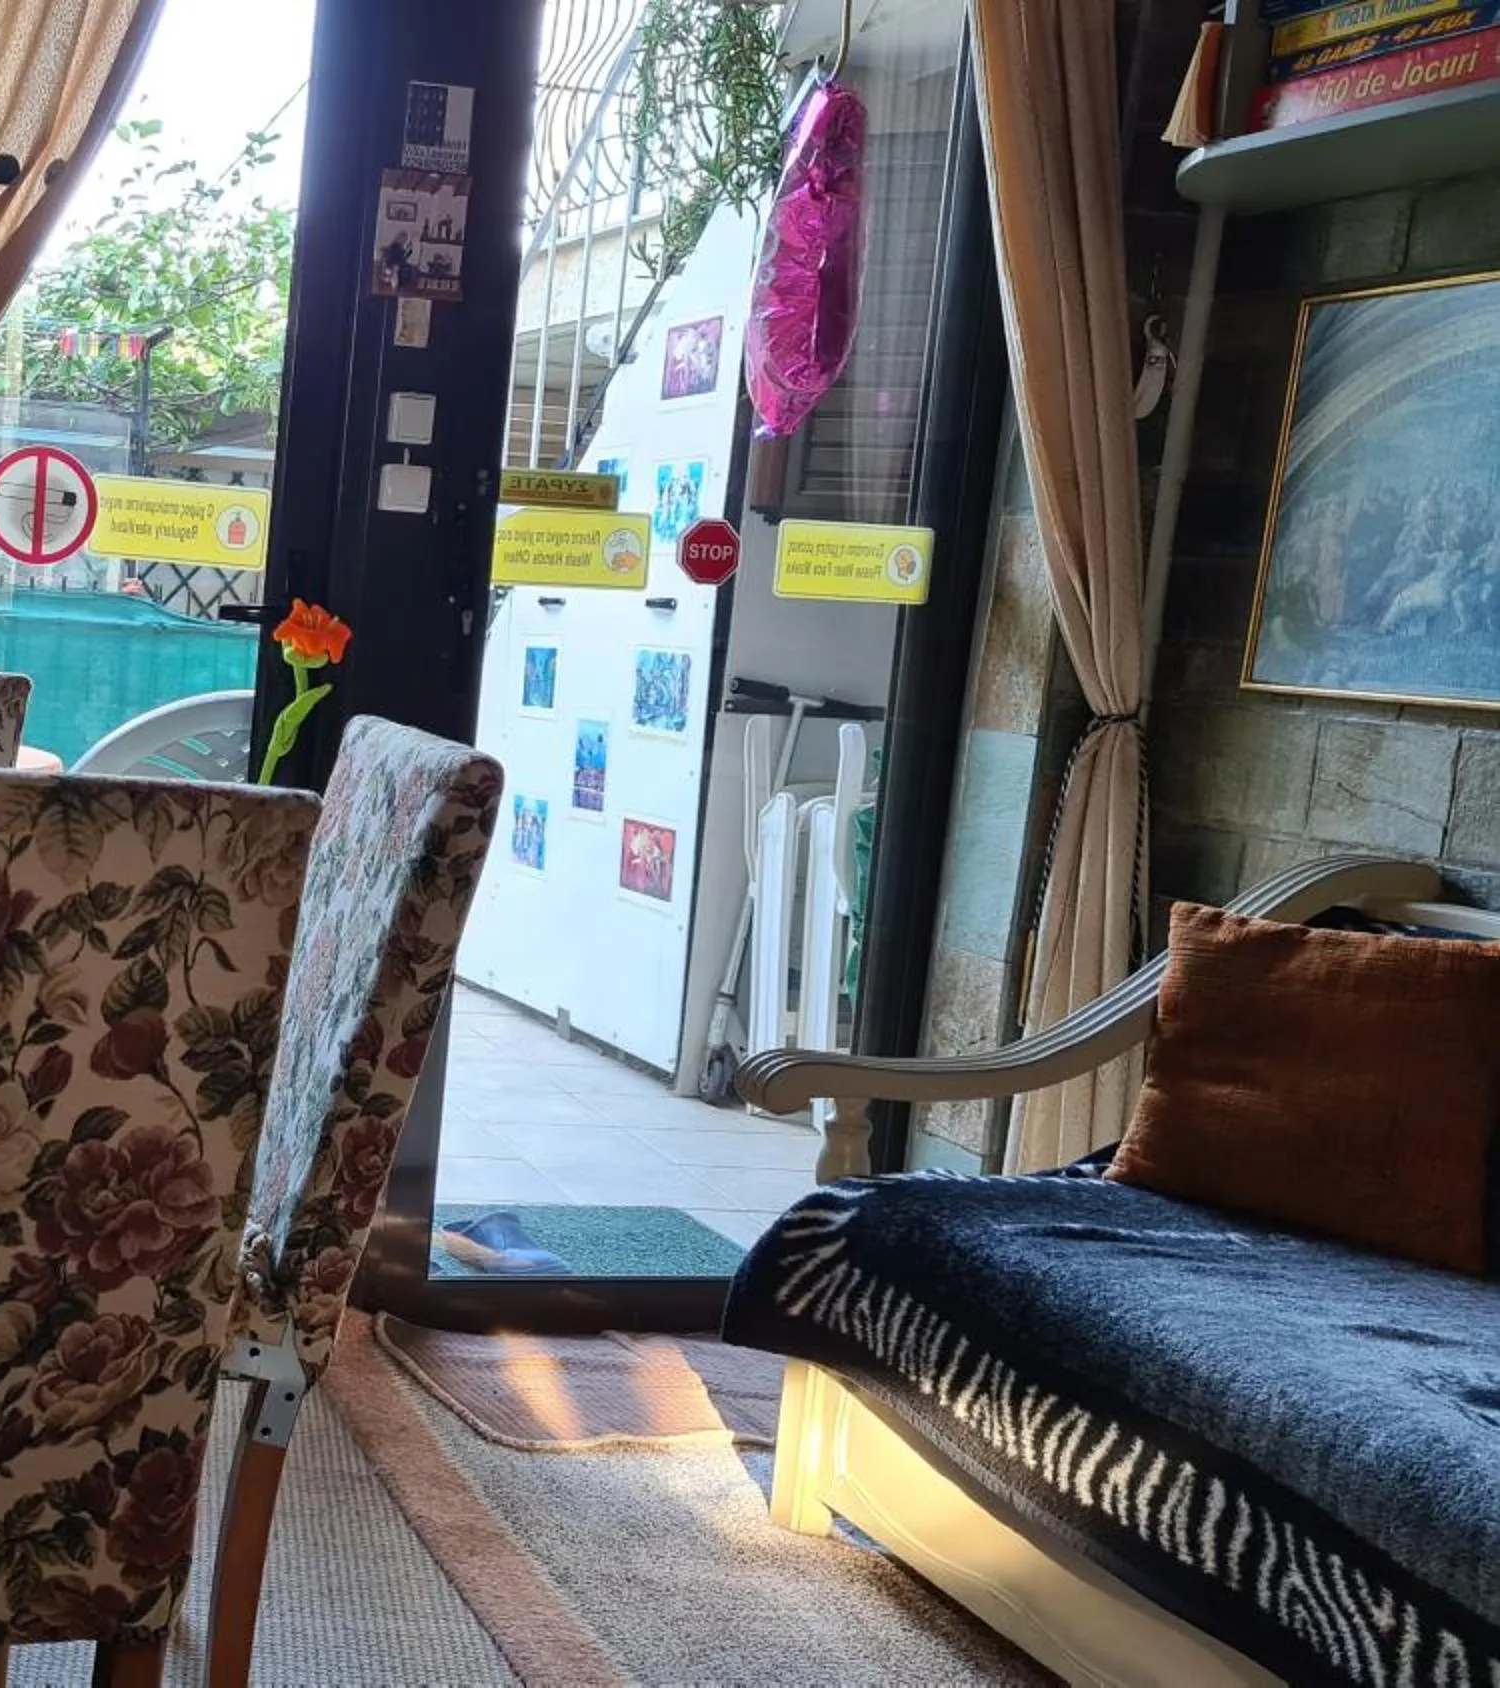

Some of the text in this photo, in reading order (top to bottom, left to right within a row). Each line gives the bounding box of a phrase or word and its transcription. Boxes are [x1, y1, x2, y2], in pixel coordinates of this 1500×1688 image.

[1422, 8, 1478, 36] JEUX
[1308, 76, 1350, 108] 150
[1355, 66, 1386, 99] de
[1392, 41, 1481, 91] Jocuri
[689, 543, 734, 561] STOP
